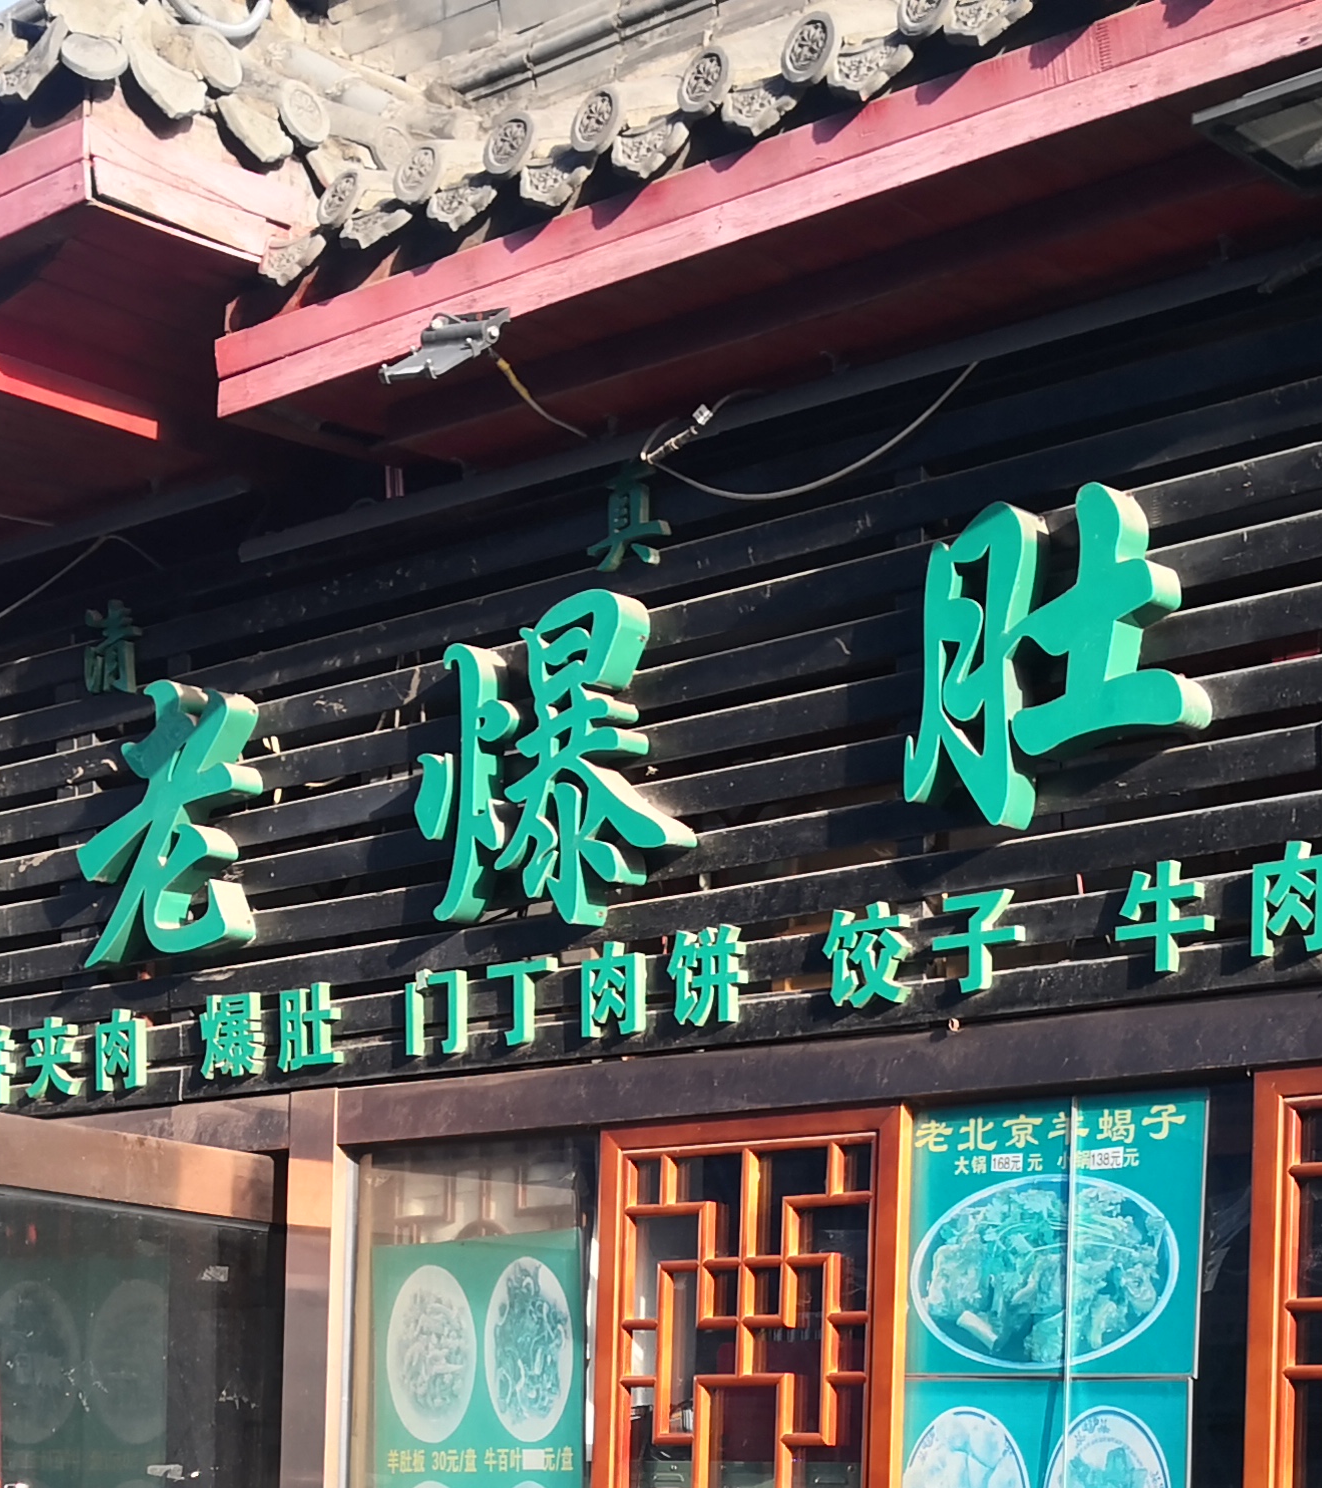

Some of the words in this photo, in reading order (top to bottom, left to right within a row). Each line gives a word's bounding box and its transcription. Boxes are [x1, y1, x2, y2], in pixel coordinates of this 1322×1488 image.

[198, 981, 347, 1081] 爆肚
[404, 923, 749, 1058] 门丁肉饼
[822, 888, 1026, 1009] 饺子
[914, 1103, 1186, 1153] 老北京羊蝎子
[388, 1448, 425, 1474] 羊肚板
[431, 1447, 477, 1473] 30元/盘
[484, 1446, 522, 1473] 牛百叶
